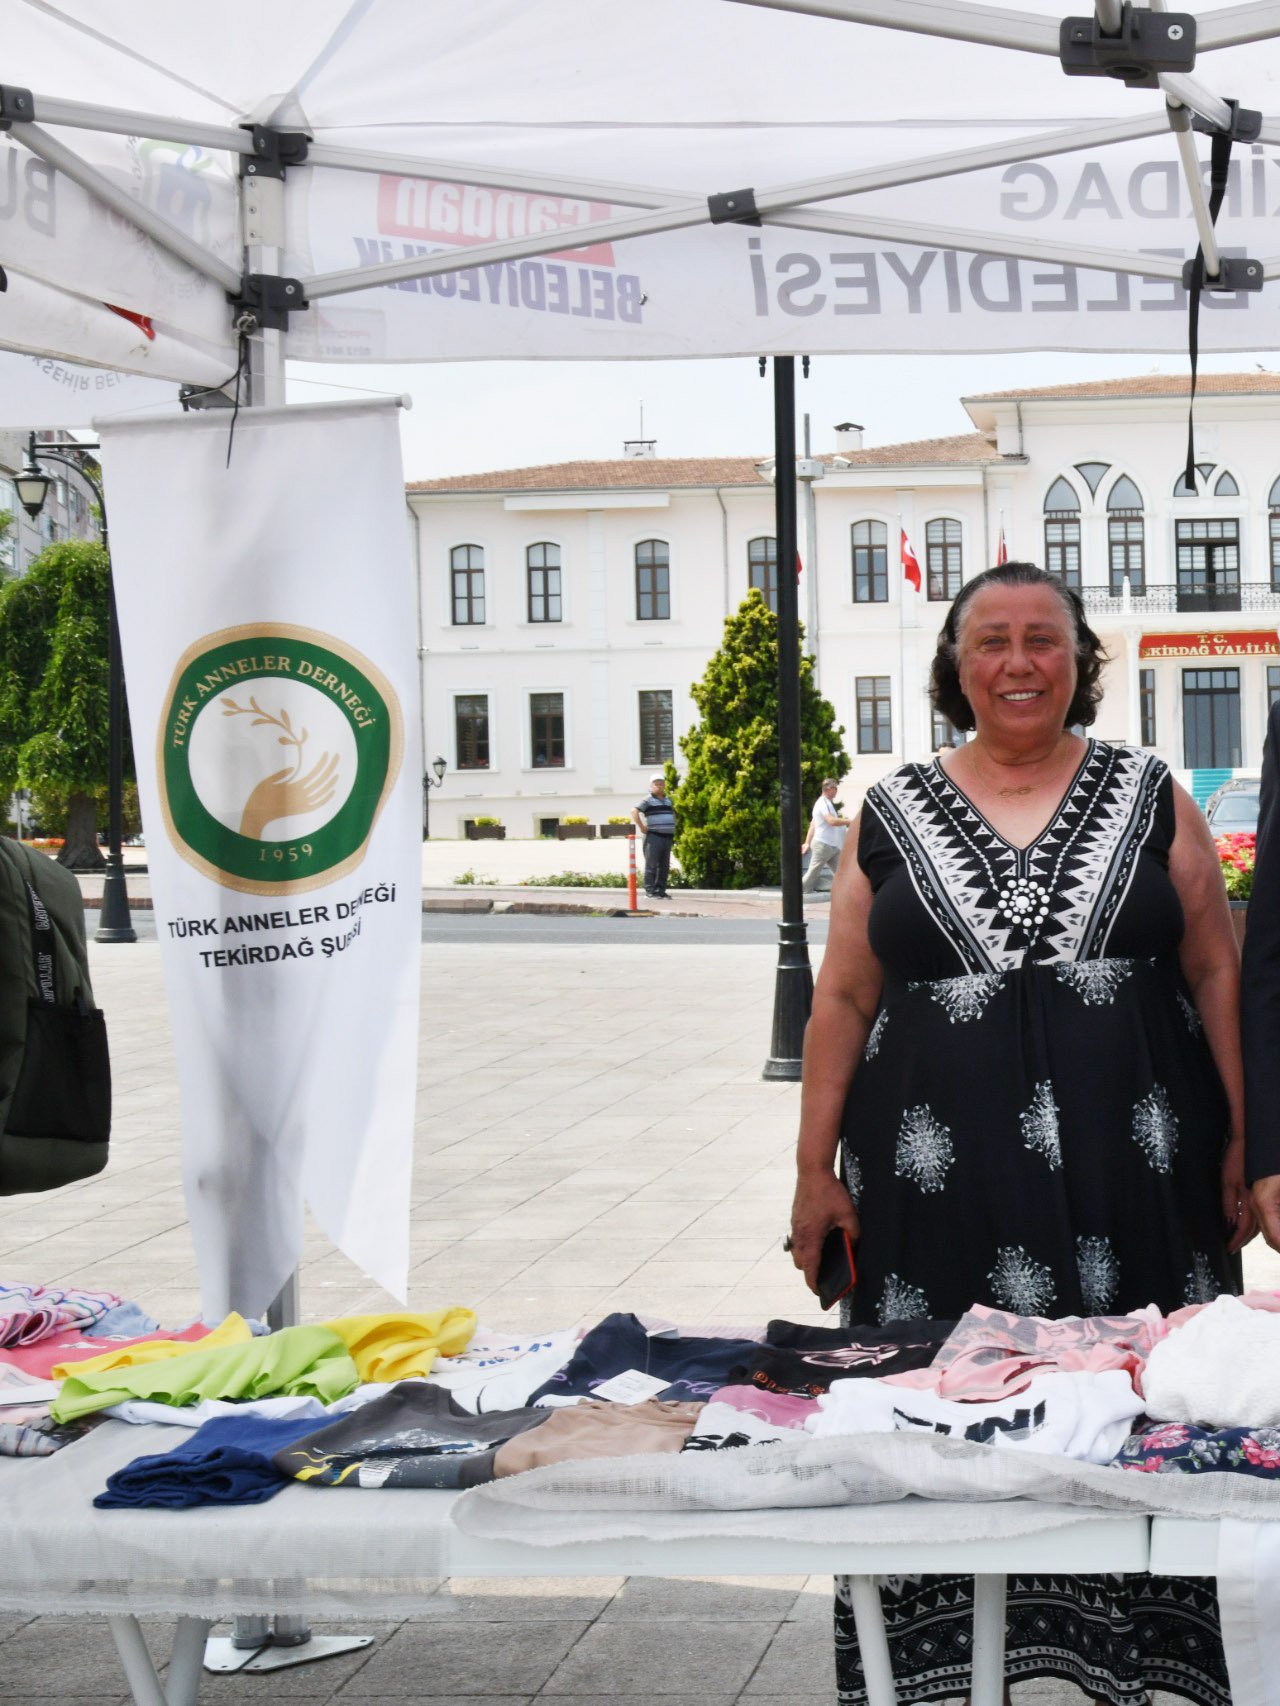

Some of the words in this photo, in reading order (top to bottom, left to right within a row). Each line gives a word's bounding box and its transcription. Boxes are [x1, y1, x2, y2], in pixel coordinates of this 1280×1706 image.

[1142, 644, 1209, 657] EKİRDAĞ
[173, 695, 199, 749] TÜRK
[196, 655, 292, 698] ANNELER
[296, 661, 377, 730] DERNEĞİ
[259, 843, 313, 862] 1959
[168, 917, 220, 939] TÜRK
[223, 905, 329, 934] ANNELER
[199, 936, 314, 968] TEKİRDAĞ
